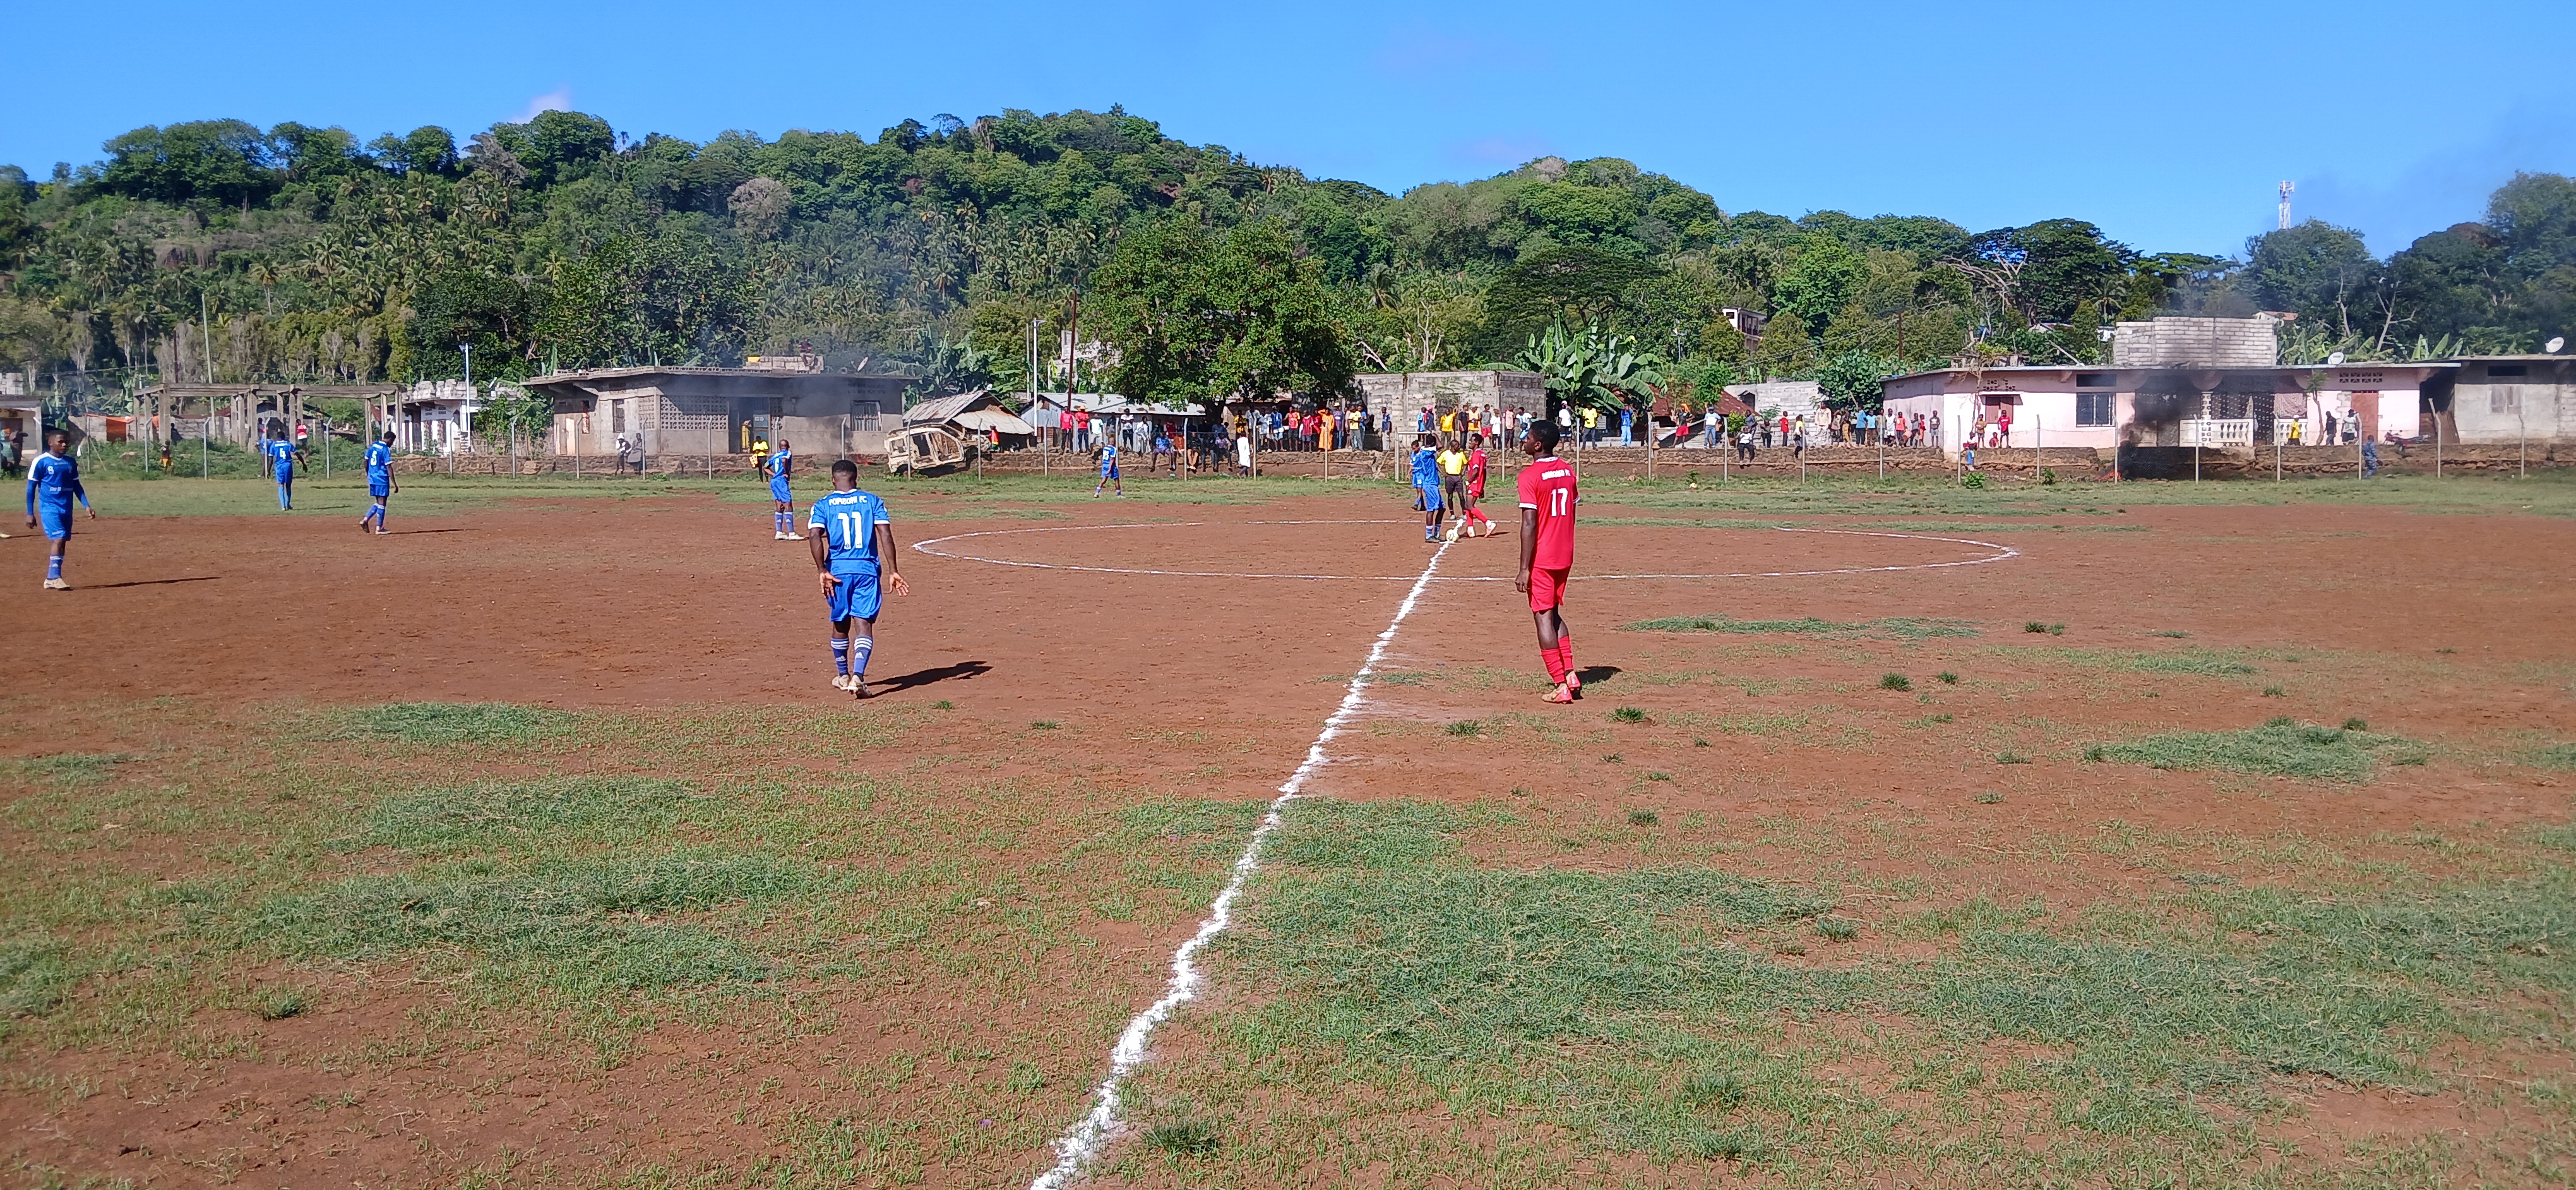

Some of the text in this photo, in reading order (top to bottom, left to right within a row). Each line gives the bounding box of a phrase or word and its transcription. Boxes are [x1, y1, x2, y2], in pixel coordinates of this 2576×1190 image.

[280, 448, 286, 459] 4
[370, 450, 377, 466] 5
[47, 466, 54, 474] 8
[1551, 488, 1568, 517] 17
[838, 511, 863, 550] 11
